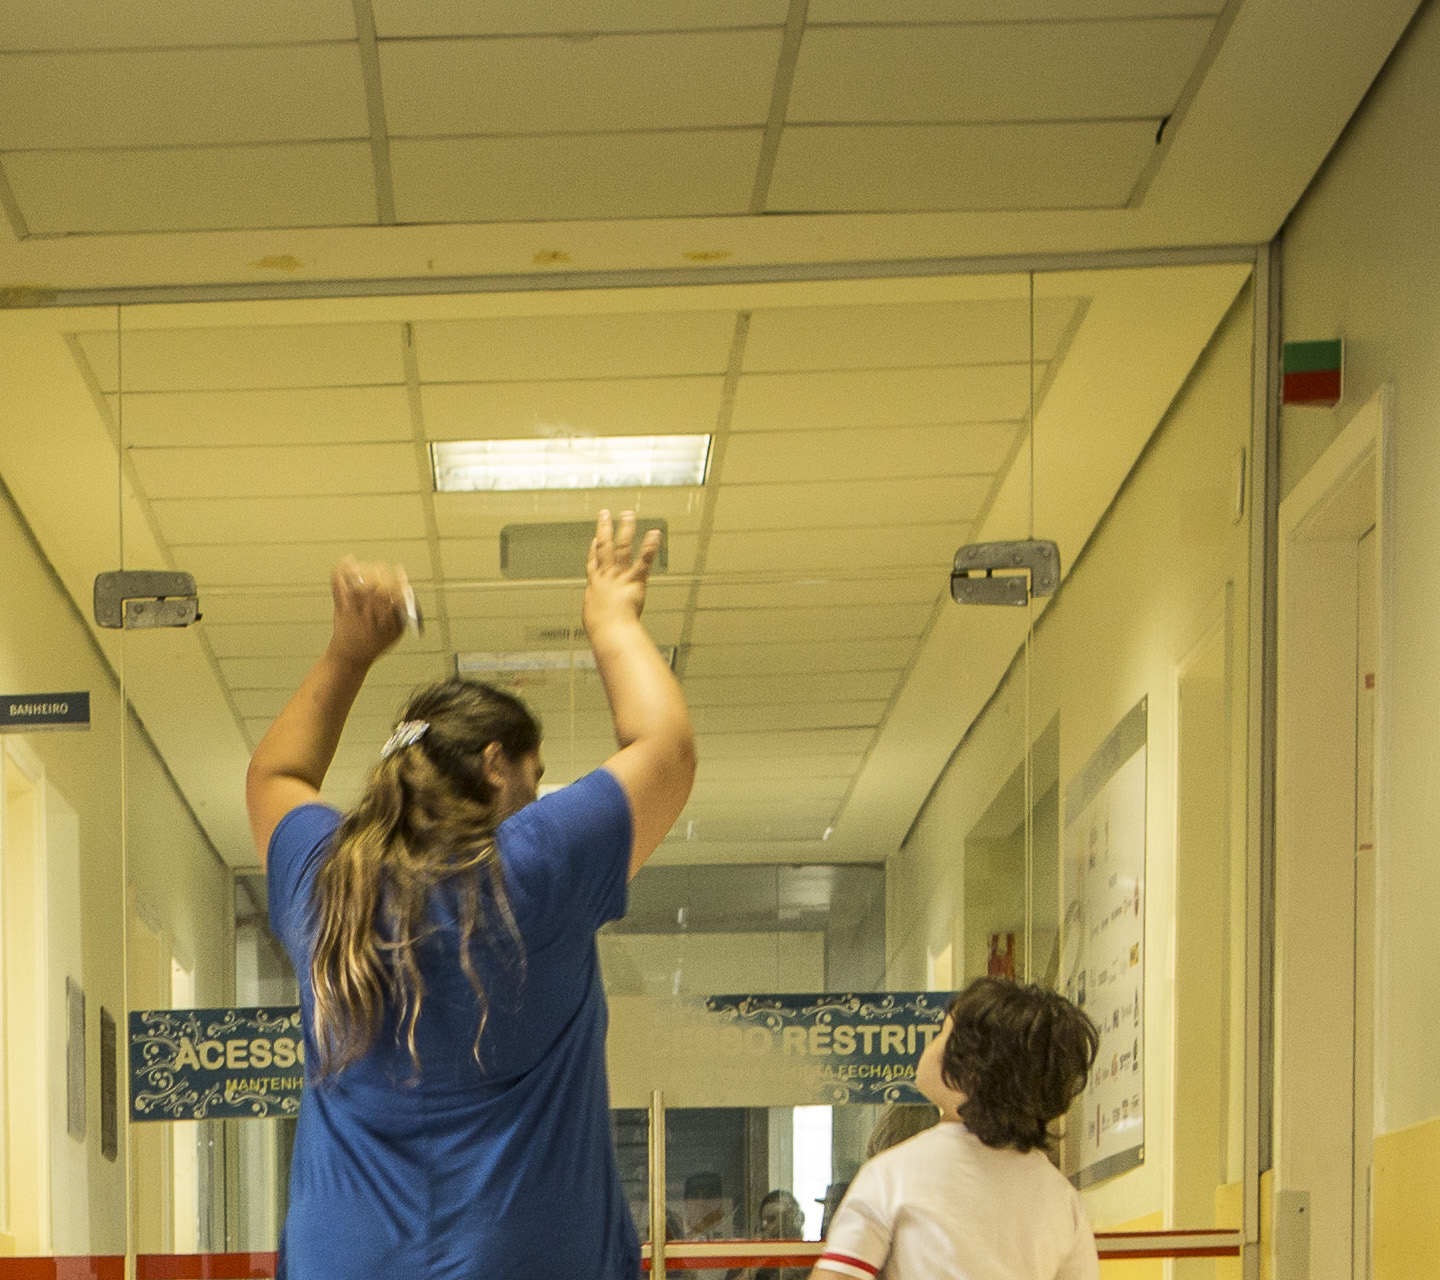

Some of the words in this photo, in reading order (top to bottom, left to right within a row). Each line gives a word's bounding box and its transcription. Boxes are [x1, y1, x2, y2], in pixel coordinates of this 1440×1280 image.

[9, 702, 69, 716] BANHEIRO
[782, 1024, 941, 1056] RESTRIT
[838, 1064, 915, 1079] FECHADA
[225, 1076, 304, 1092] MANTENH
